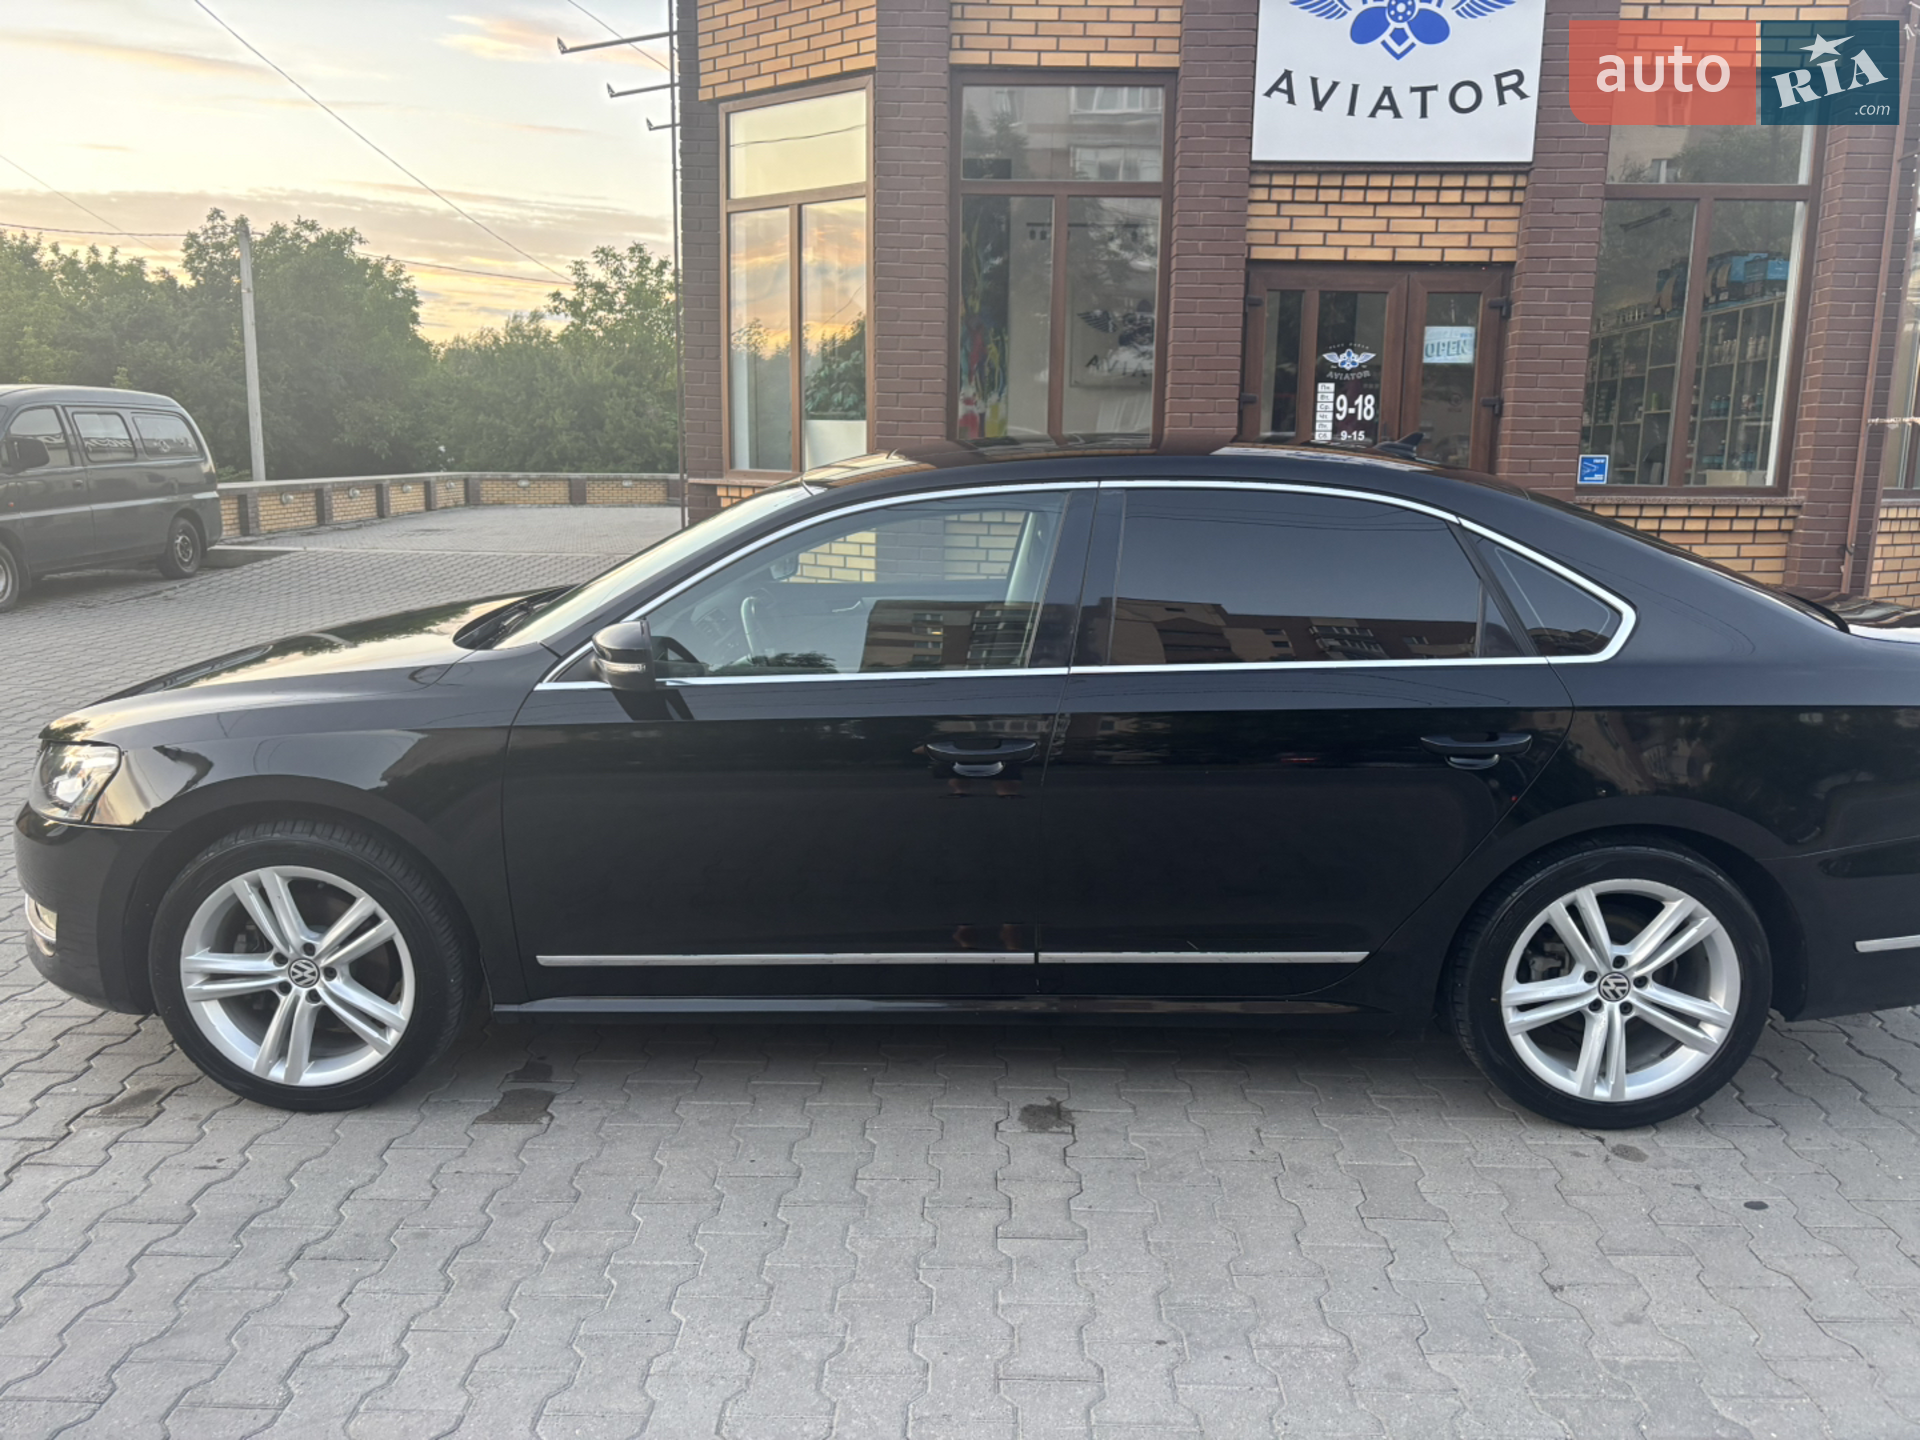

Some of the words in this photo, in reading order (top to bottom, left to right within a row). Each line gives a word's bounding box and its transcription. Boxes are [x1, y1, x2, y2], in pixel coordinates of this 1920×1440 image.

[1263, 68, 1531, 119] AVIATOR
[1326, 370, 1371, 381] AVIATOR
[1335, 394, 1375, 421] 9-18
[1340, 430, 1365, 441] 9-15
